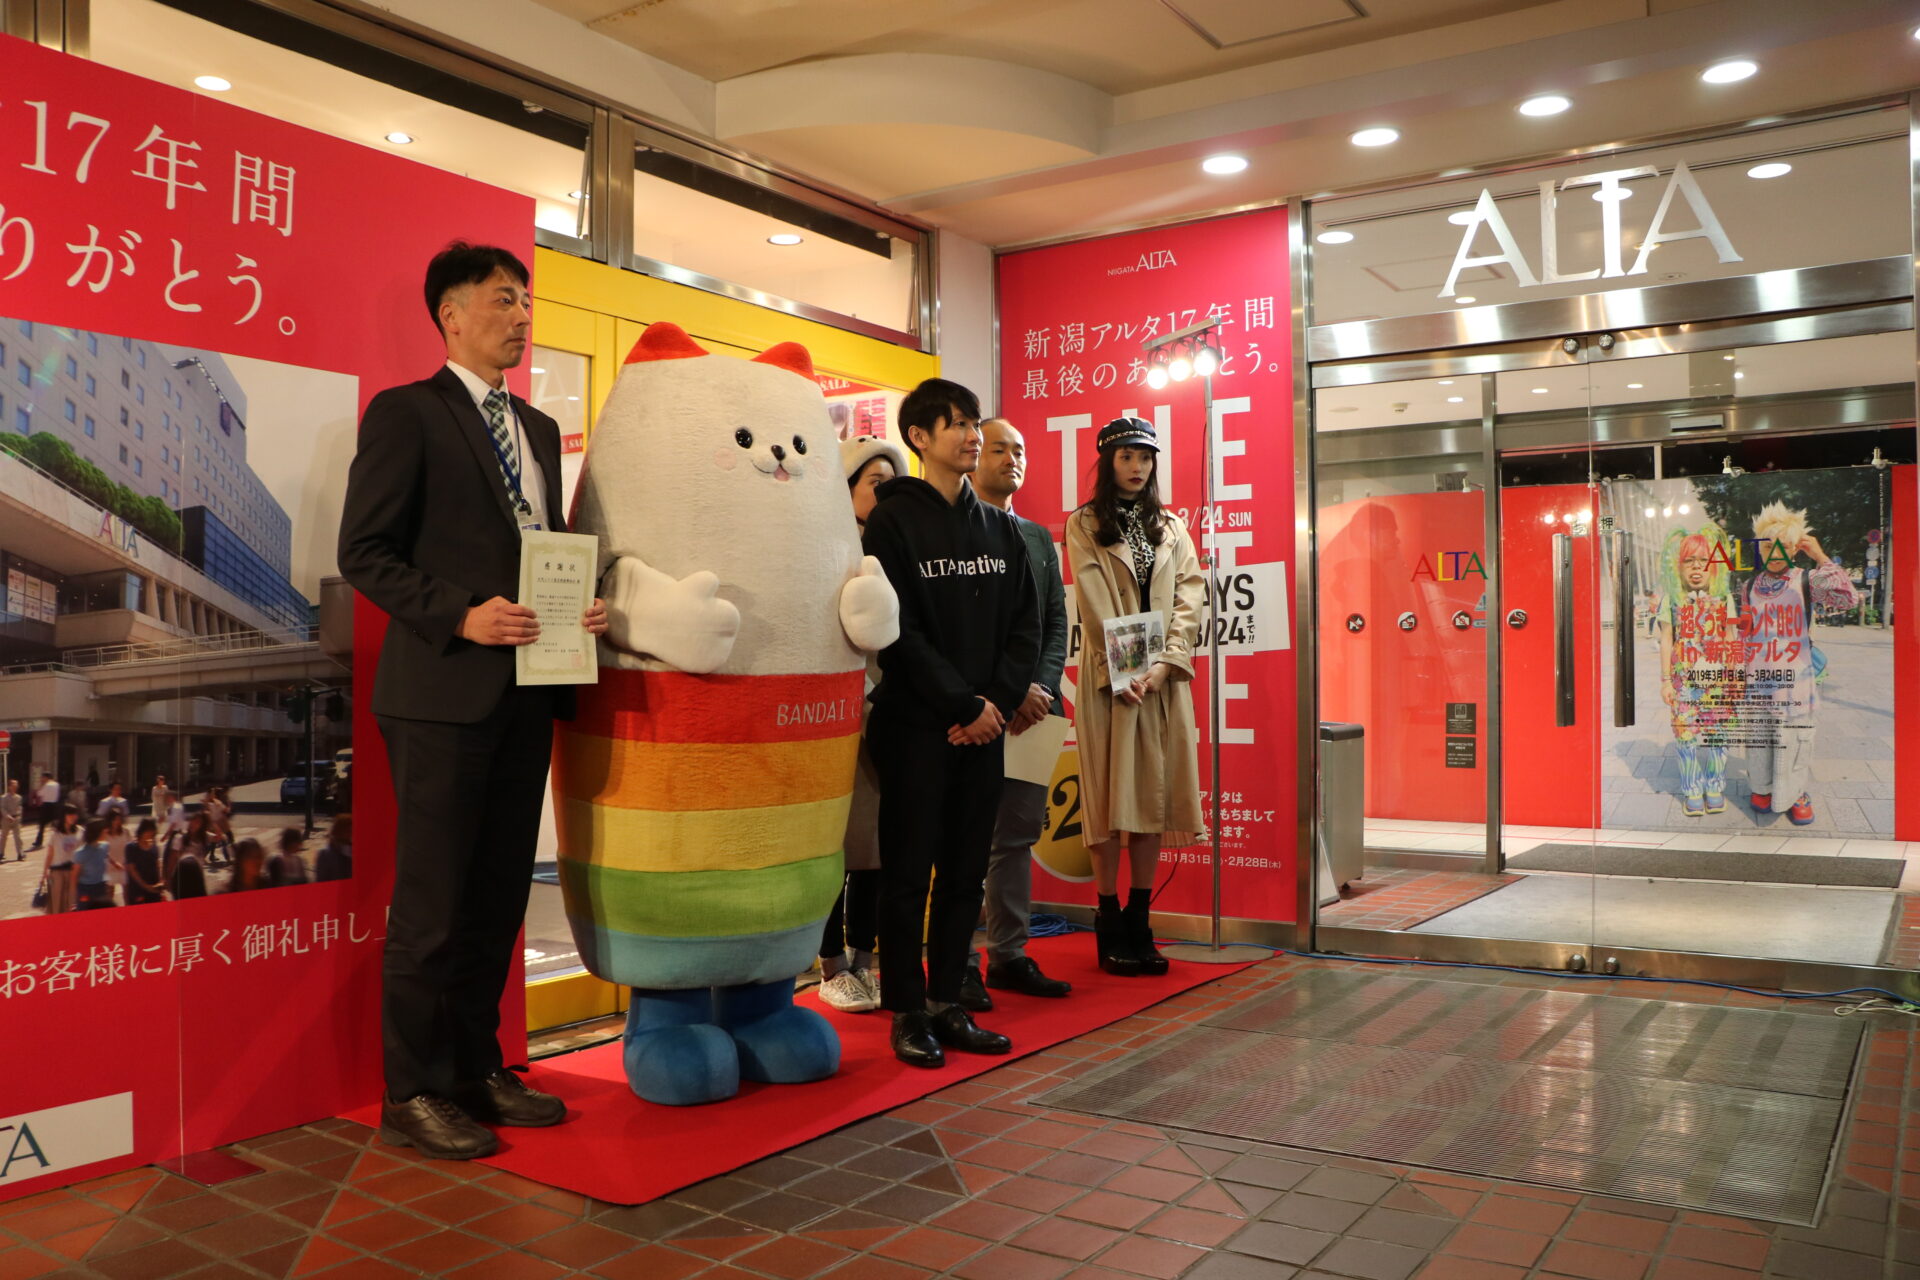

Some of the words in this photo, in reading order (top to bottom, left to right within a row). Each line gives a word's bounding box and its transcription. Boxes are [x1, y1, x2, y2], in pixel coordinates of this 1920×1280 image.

[20, 100, 297, 238] 17年間
[1437, 158, 1744, 298] ALTA
[1136, 249, 1178, 272] ALTA
[820, 380, 851, 391] SALE
[1022, 342, 1279, 401] 最後のあとう。
[1228, 511, 1252, 527] SUN
[920, 554, 1006, 578] ALTAnative
[1411, 551, 1488, 582] ALTA
[1703, 537, 1794, 572] ALTA
[1704, 638, 1801, 664] 新潟アルタ
[776, 698, 846, 727] BANDAI
